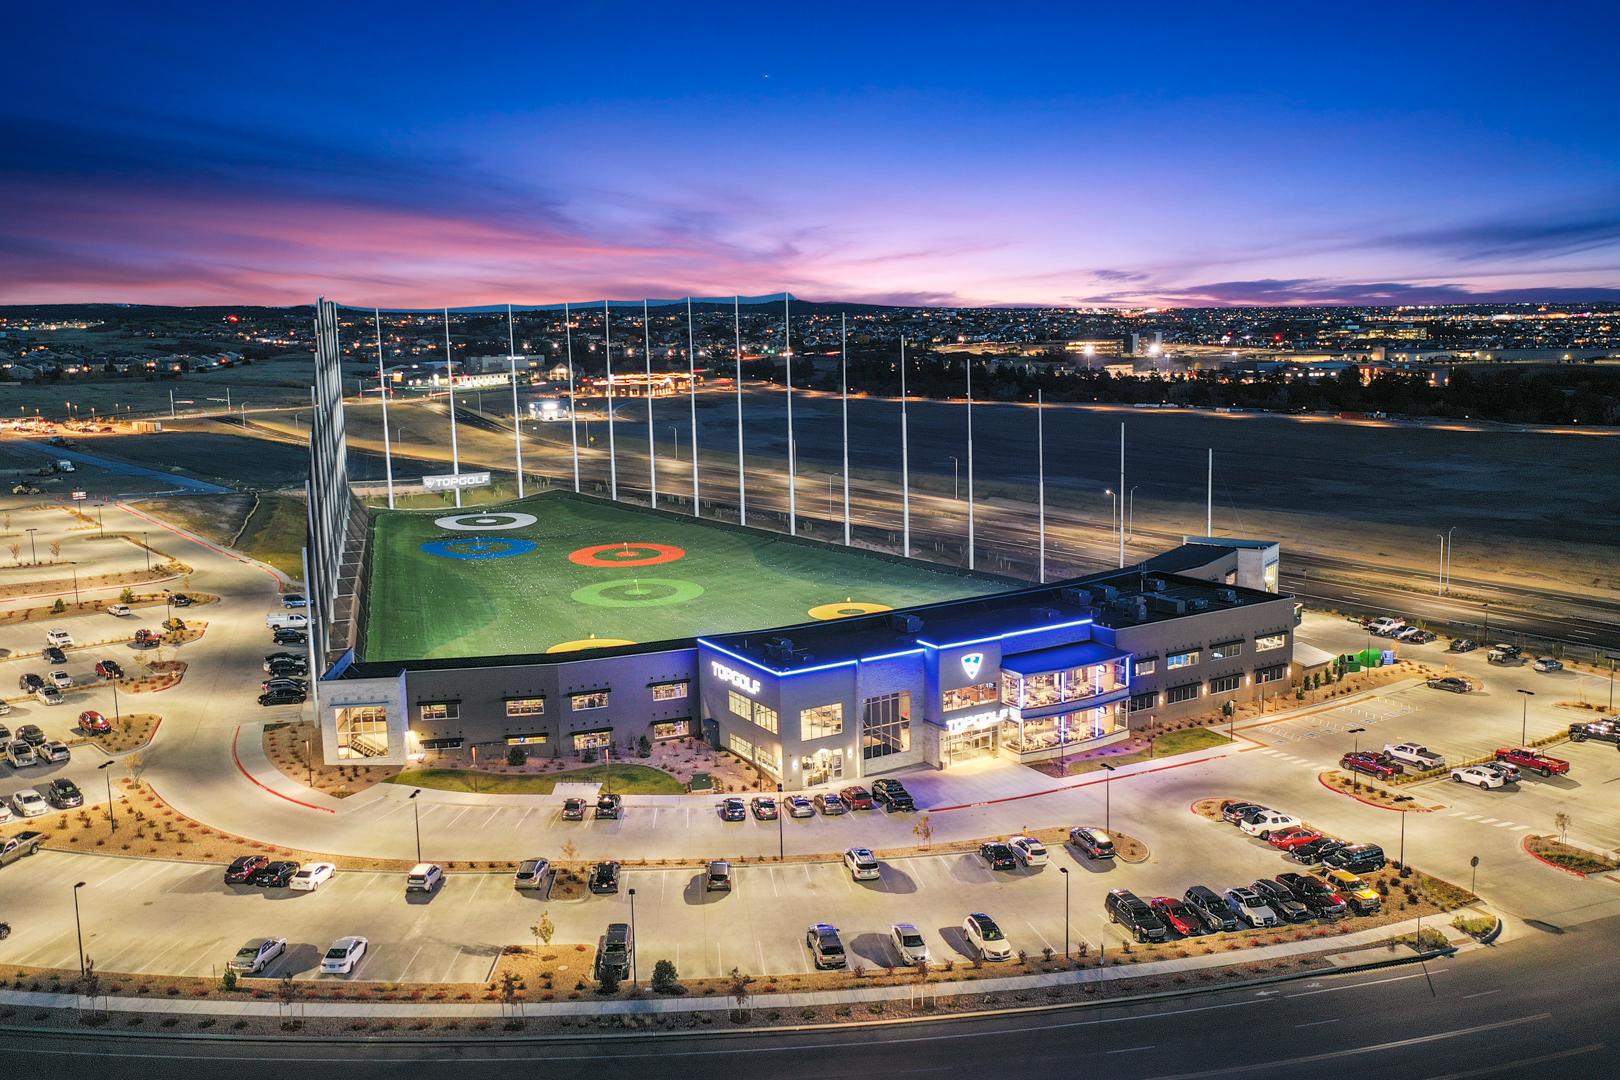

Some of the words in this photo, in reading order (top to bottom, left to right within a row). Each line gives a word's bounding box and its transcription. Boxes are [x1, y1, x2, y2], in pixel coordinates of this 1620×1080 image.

[436, 475, 489, 487] TOPGOLF
[711, 661, 760, 694] TOPGOLF
[946, 708, 1009, 733] TOPGOLF
